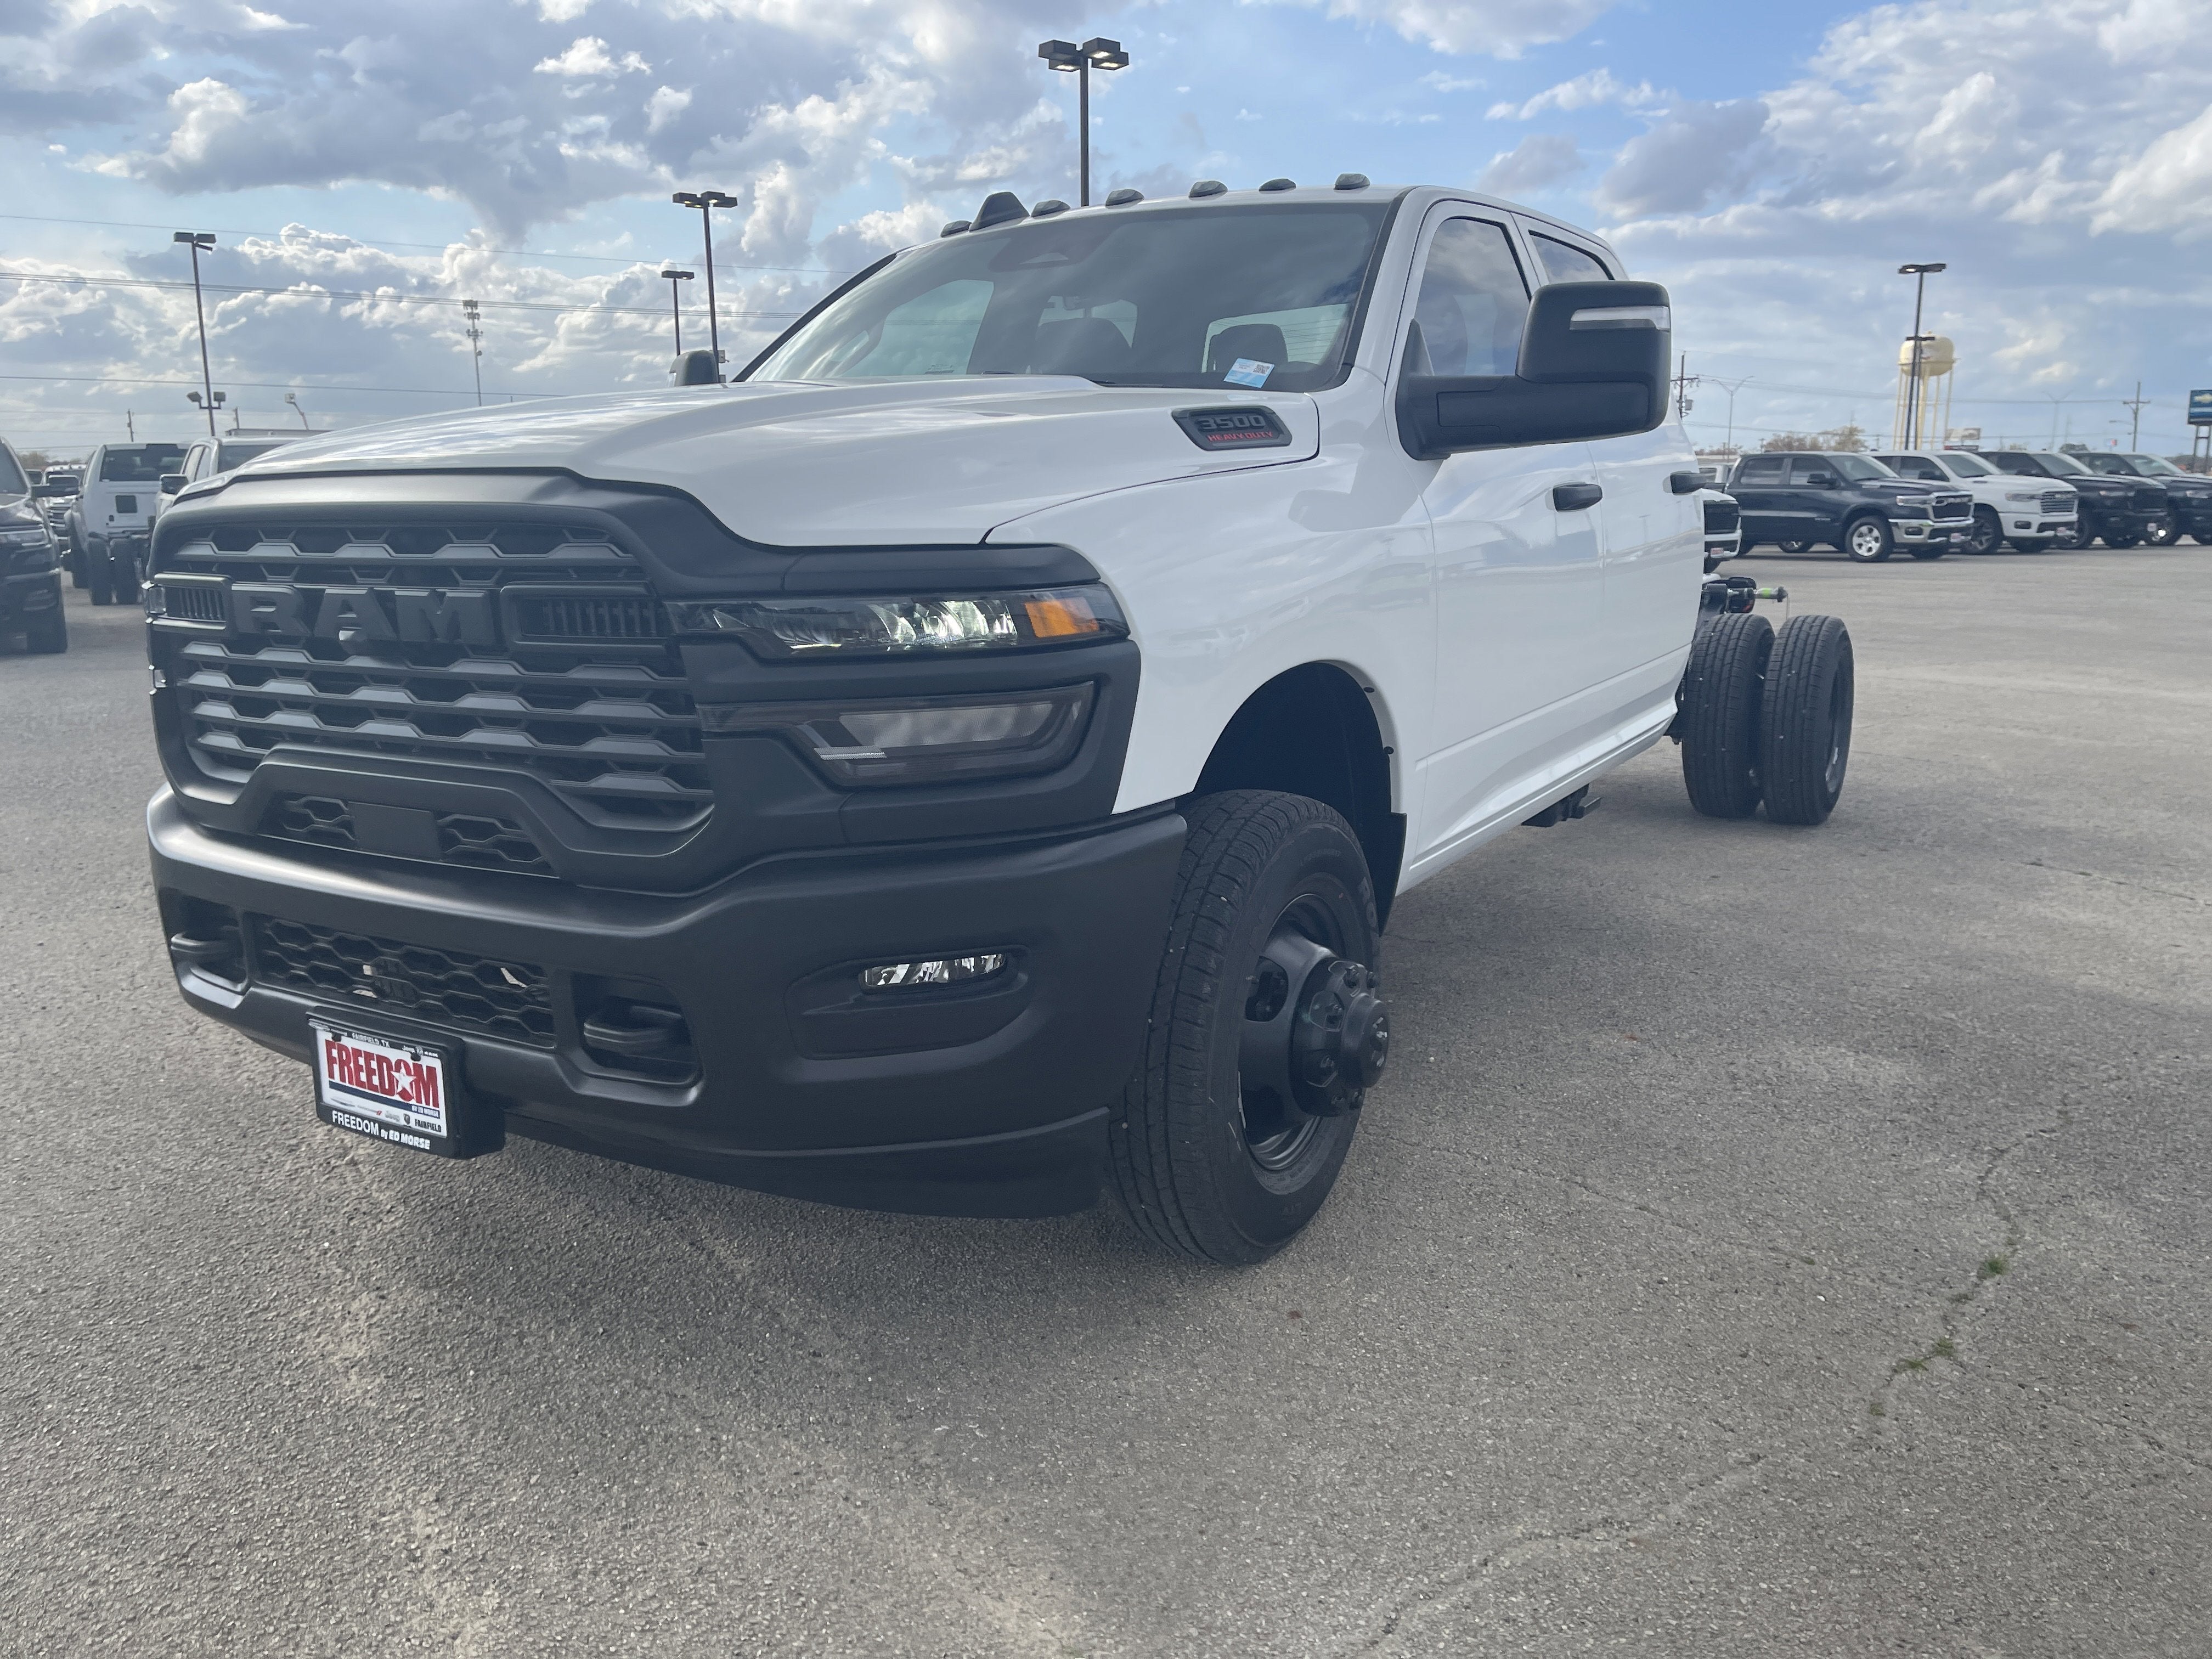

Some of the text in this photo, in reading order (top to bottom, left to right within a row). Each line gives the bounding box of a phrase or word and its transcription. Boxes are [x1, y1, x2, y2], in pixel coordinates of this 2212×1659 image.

[1198, 415, 1266, 431] 3500
[1207, 431, 1273, 442] HEAVY DUTY
[231, 583, 493, 645] RAM
[324, 1039, 439, 1109] FREEDOM
[332, 1110, 379, 1136] FREEDOM
[389, 1130, 400, 1142] ED
[400, 1133, 430, 1150] MORSE
[414, 1119, 442, 1132] FAIRFIELD
